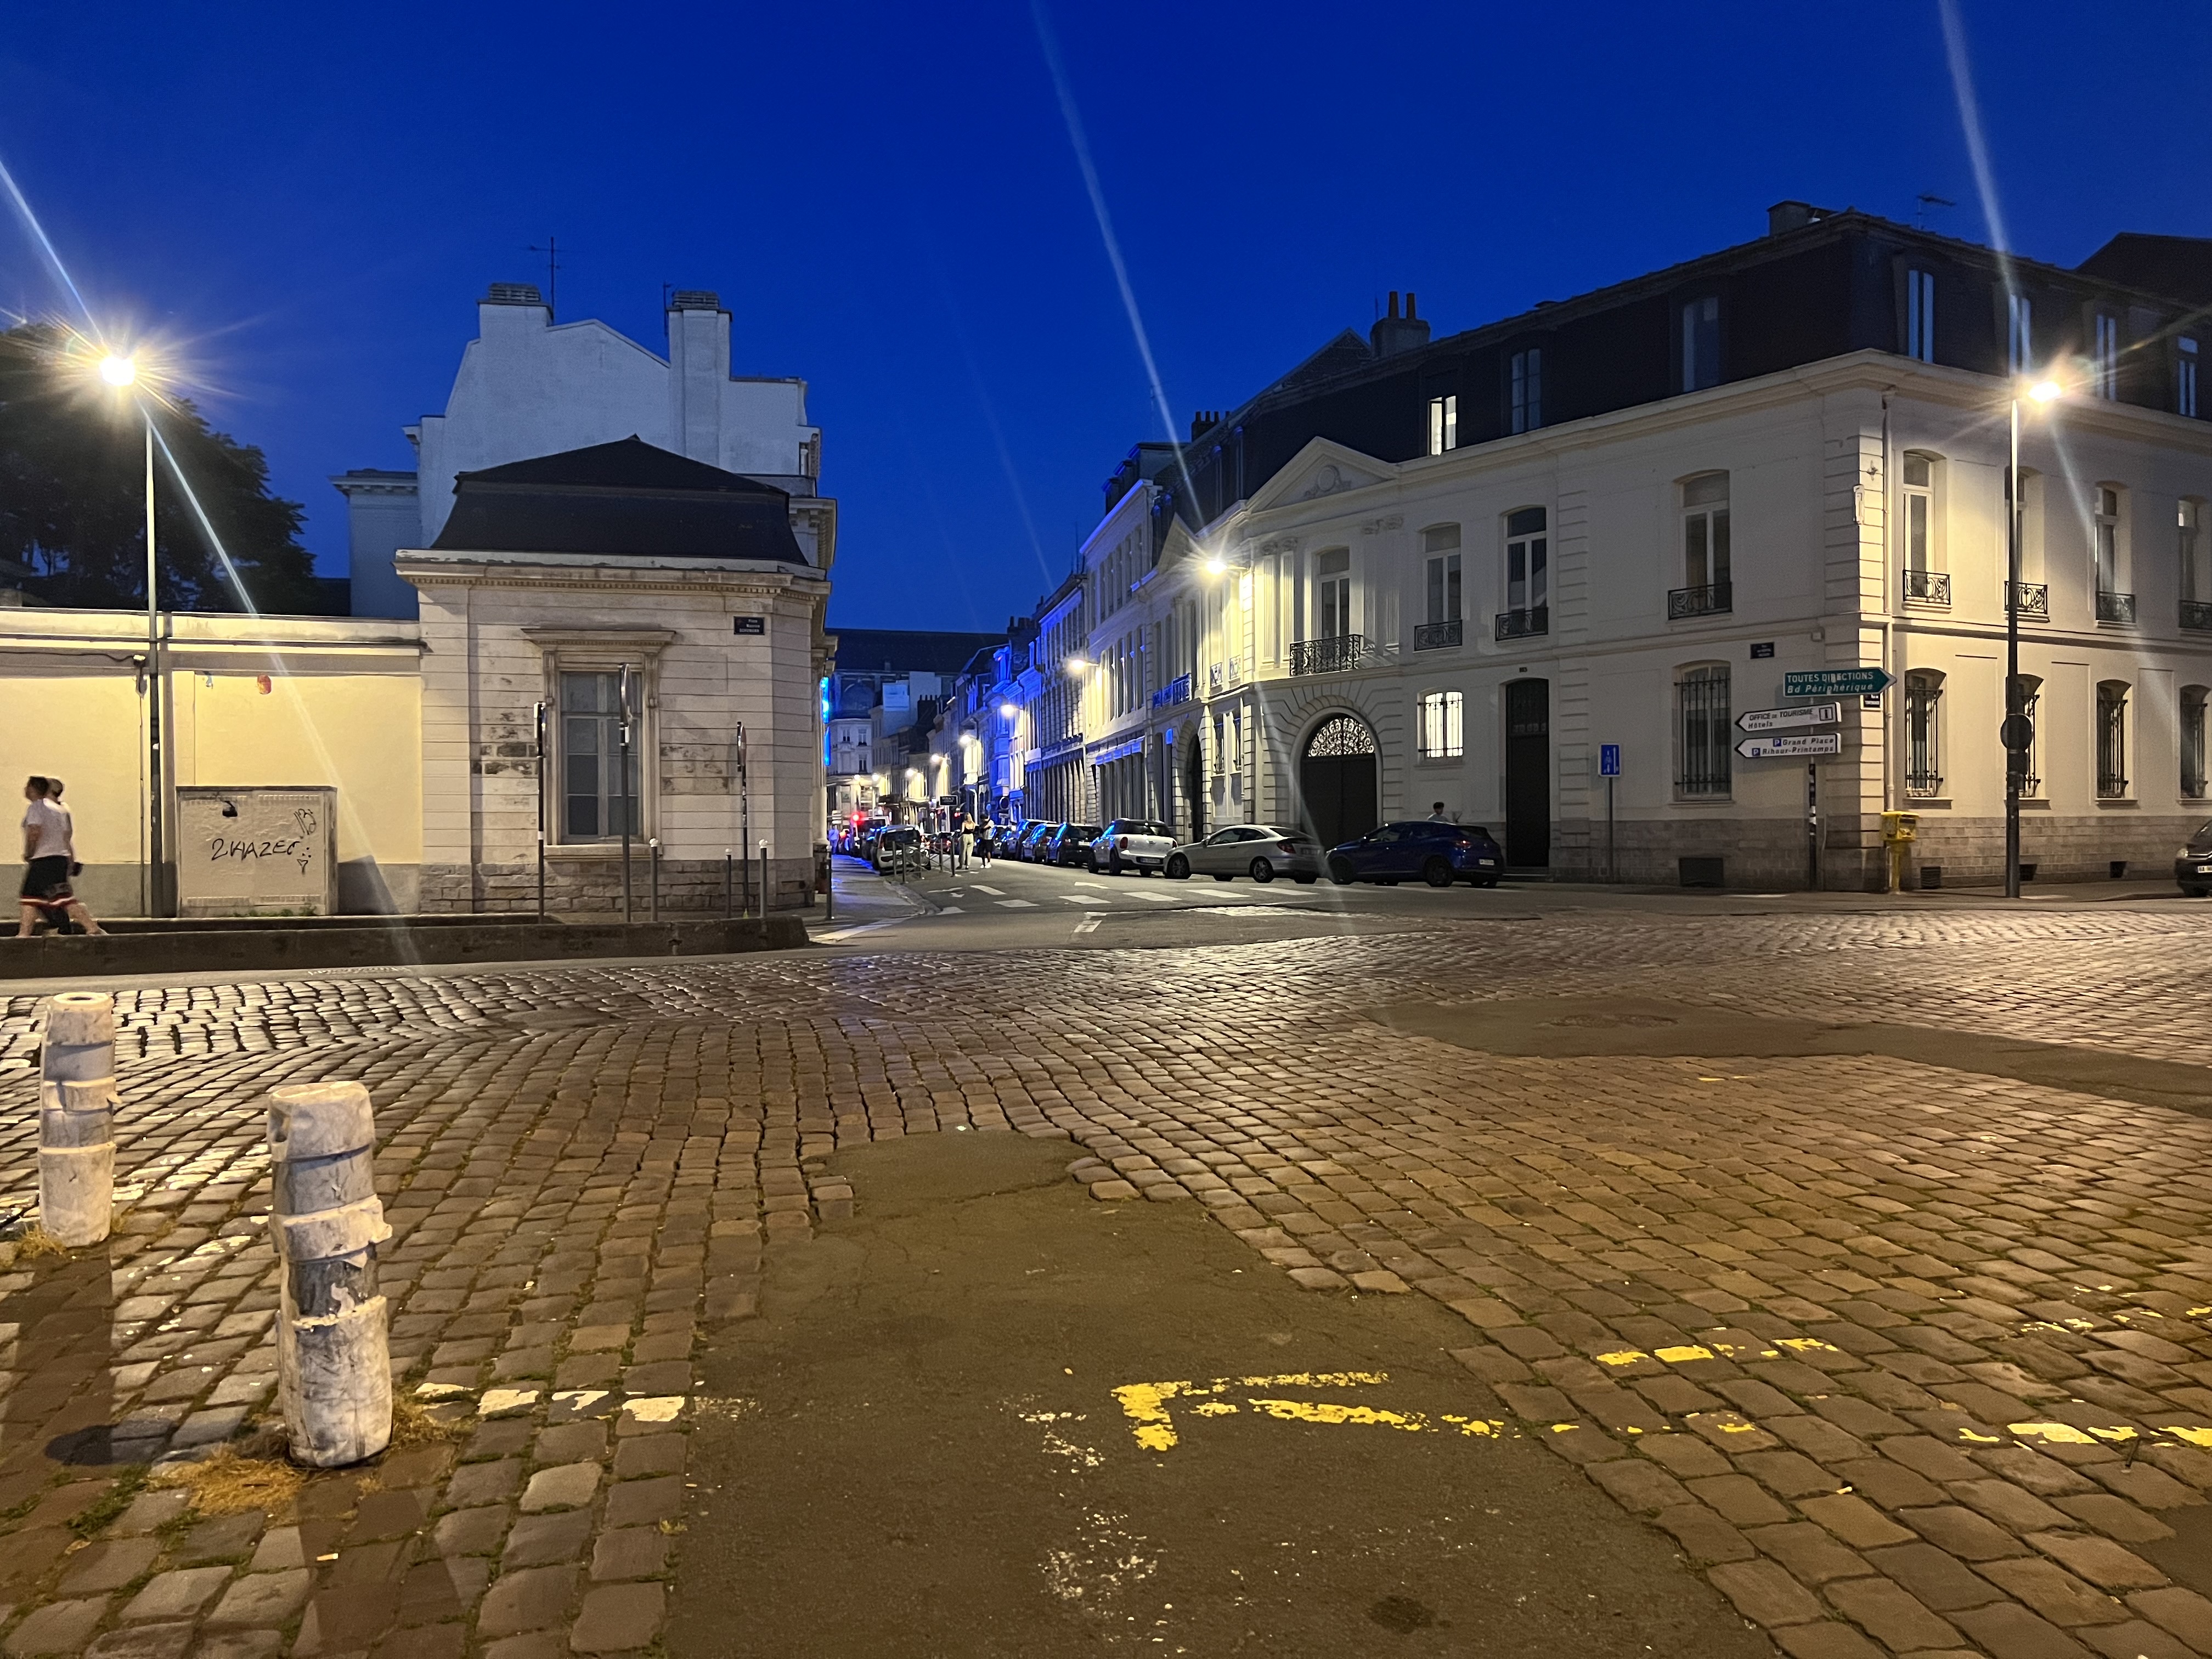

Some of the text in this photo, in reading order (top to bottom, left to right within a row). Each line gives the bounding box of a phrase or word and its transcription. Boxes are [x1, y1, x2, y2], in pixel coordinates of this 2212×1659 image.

[1787, 672, 1874, 683] TOUTES DIRECTIONS
[1787, 684, 1874, 694] Bd Périphérique
[1780, 708, 1813, 718] TOURISME
[1748, 721, 1773, 729] Hôtels
